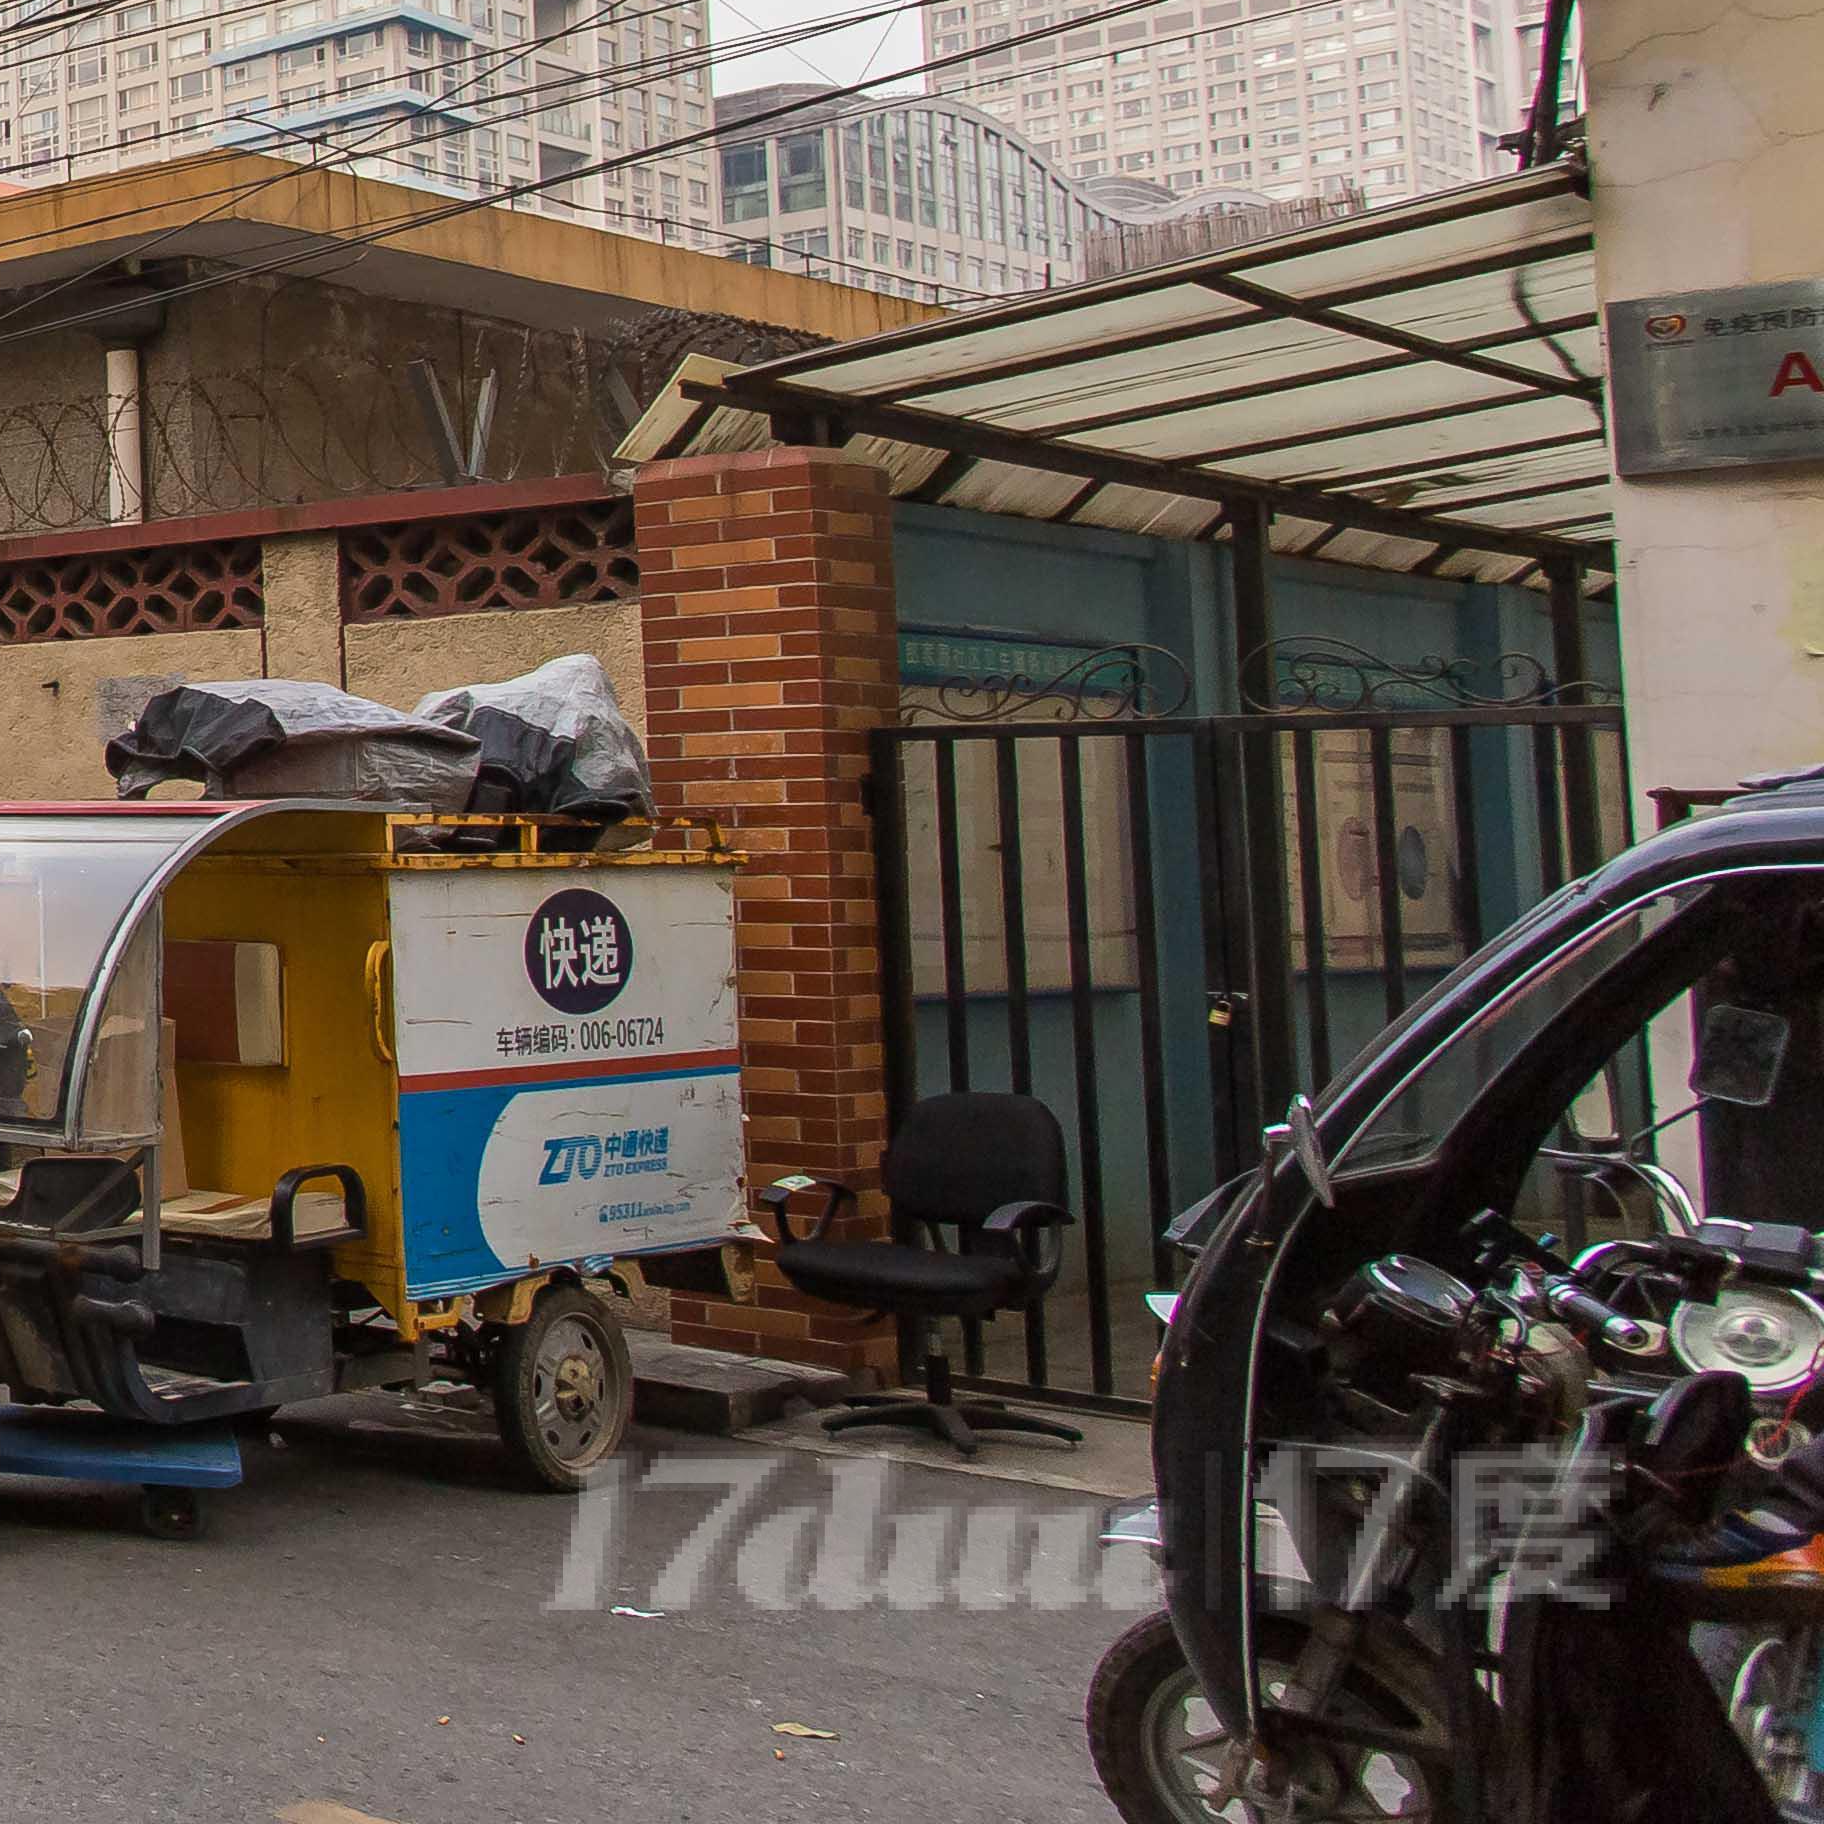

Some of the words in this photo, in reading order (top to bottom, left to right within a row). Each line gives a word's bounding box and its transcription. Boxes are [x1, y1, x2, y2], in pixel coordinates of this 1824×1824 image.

[539, 916, 620, 989] 快递
[539, 1136, 602, 1185] ZTO
[604, 1127, 670, 1160] 中通快递
[625, 1158, 668, 1175] EXPRESS
